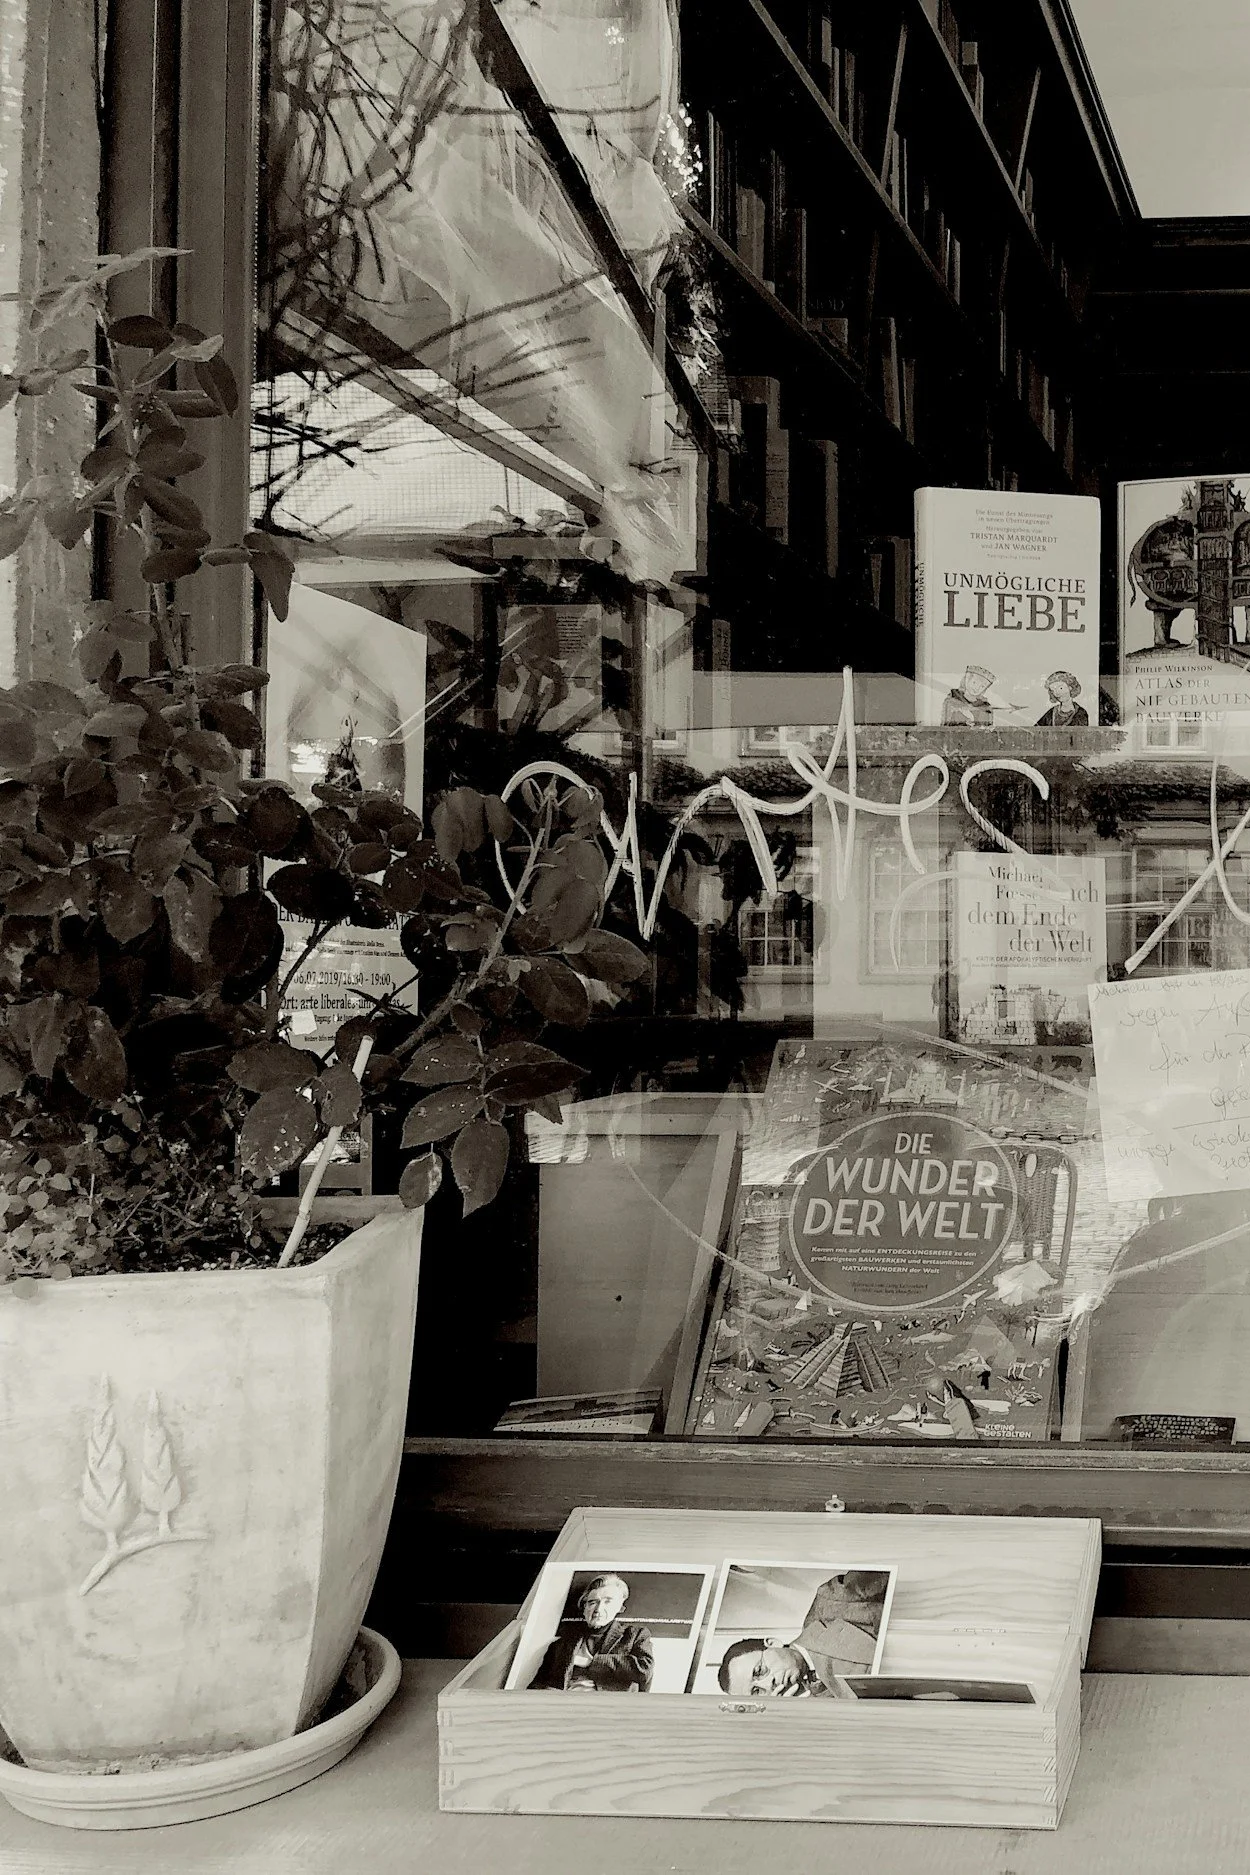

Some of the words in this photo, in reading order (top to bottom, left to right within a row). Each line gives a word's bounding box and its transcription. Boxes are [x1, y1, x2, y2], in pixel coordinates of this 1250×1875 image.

[970, 532, 1004, 541] TRISTAN
[1007, 534, 1058, 543] MARQUARDT
[994, 542, 1010, 550] JAN
[1012, 543, 1047, 552] WAGNER
[944, 572, 1086, 594] UNMÖGLICHE
[943, 590, 1086, 633] LIEBE
[1135, 678, 1182, 689] ATLAS
[1136, 695, 1162, 707] NIE
[968, 902, 1014, 925] dem
[1023, 903, 1077, 926] Ende
[1009, 929, 1044, 952] der
[1049, 930, 1093, 953] Welt
[894, 1132, 934, 1154] DIE
[826, 1157, 1000, 1197] WUNDER
[802, 1198, 886, 1237] DER
[898, 1200, 1004, 1240] WELT
[841, 1265, 908, 1273] NATURWUNDERN
